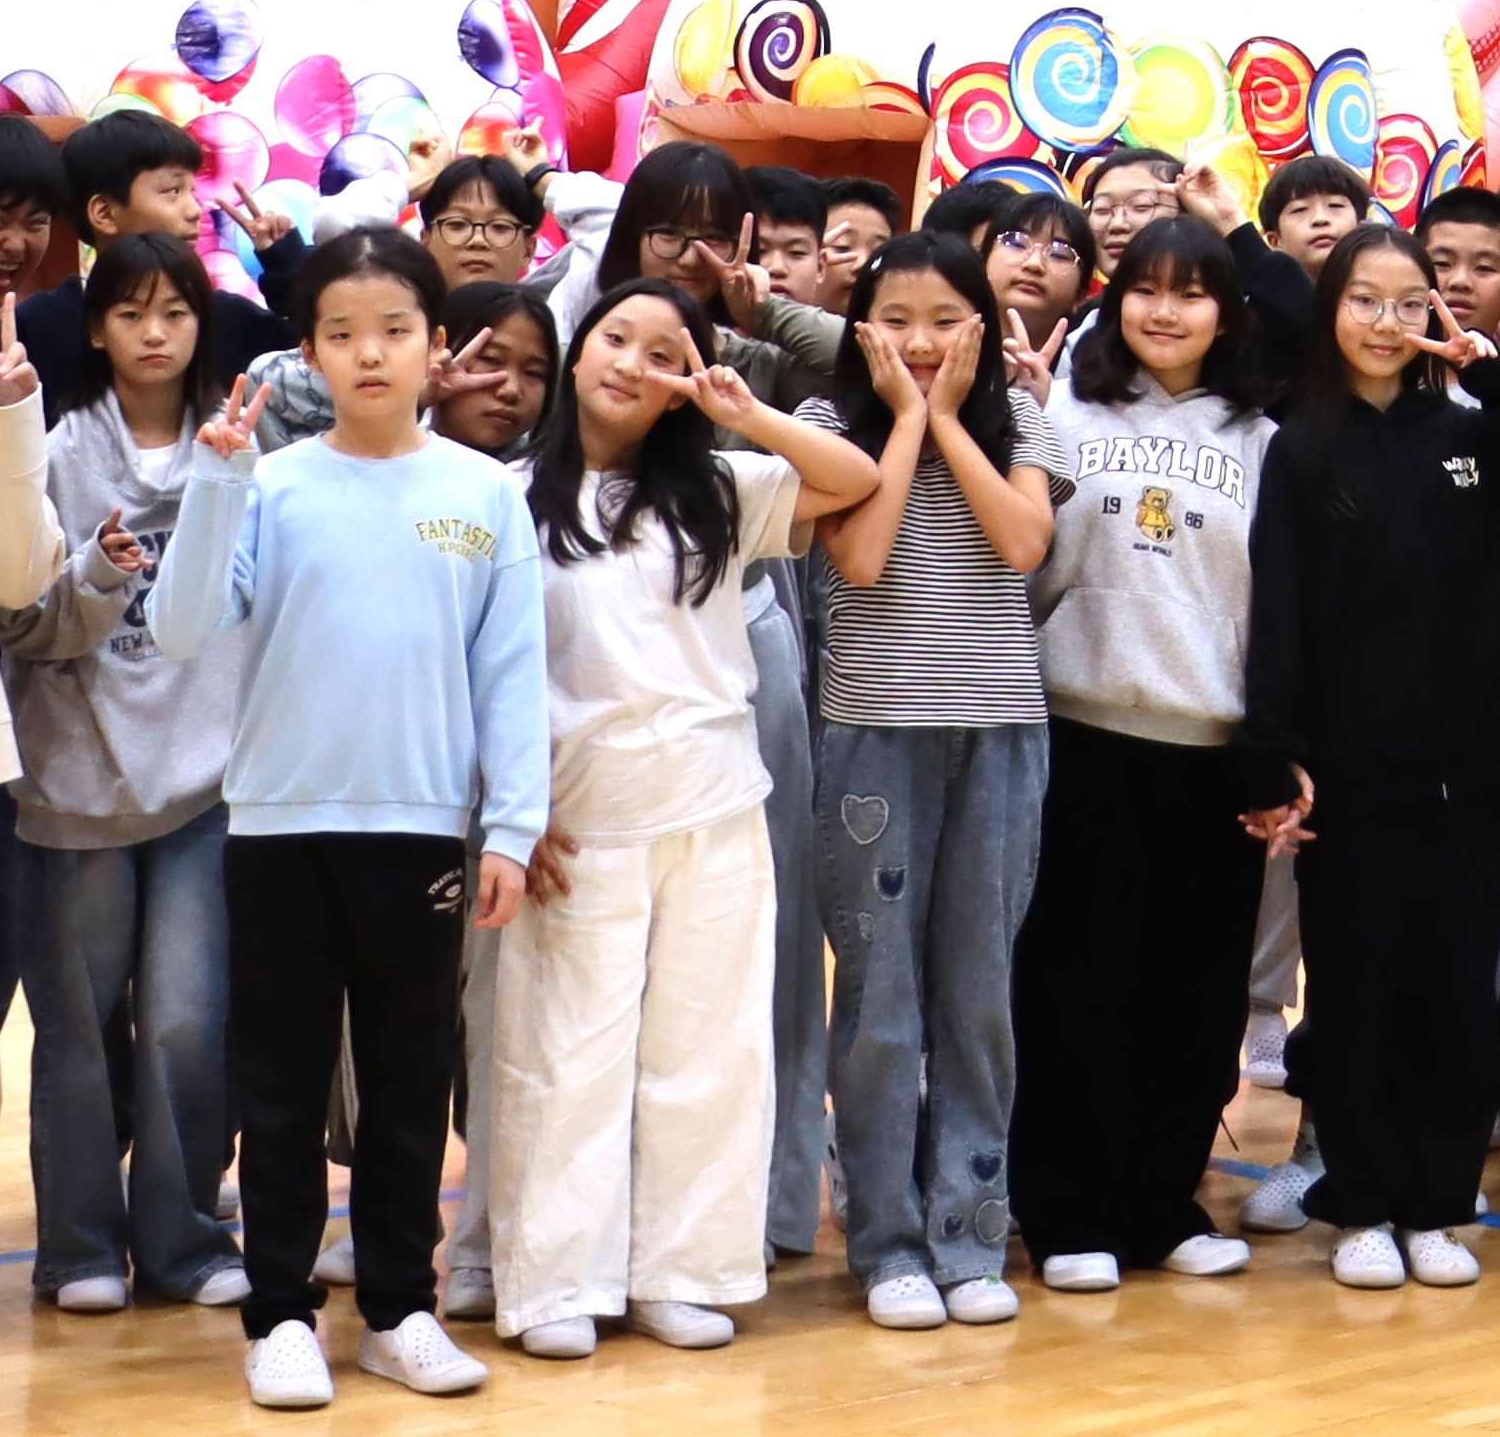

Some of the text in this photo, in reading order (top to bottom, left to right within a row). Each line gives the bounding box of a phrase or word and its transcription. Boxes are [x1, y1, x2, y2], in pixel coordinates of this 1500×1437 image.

[1076, 435, 1246, 510] BAYLOR
[1102, 495, 1204, 530] 19 86
[415, 518, 497, 559] FANTASTI
